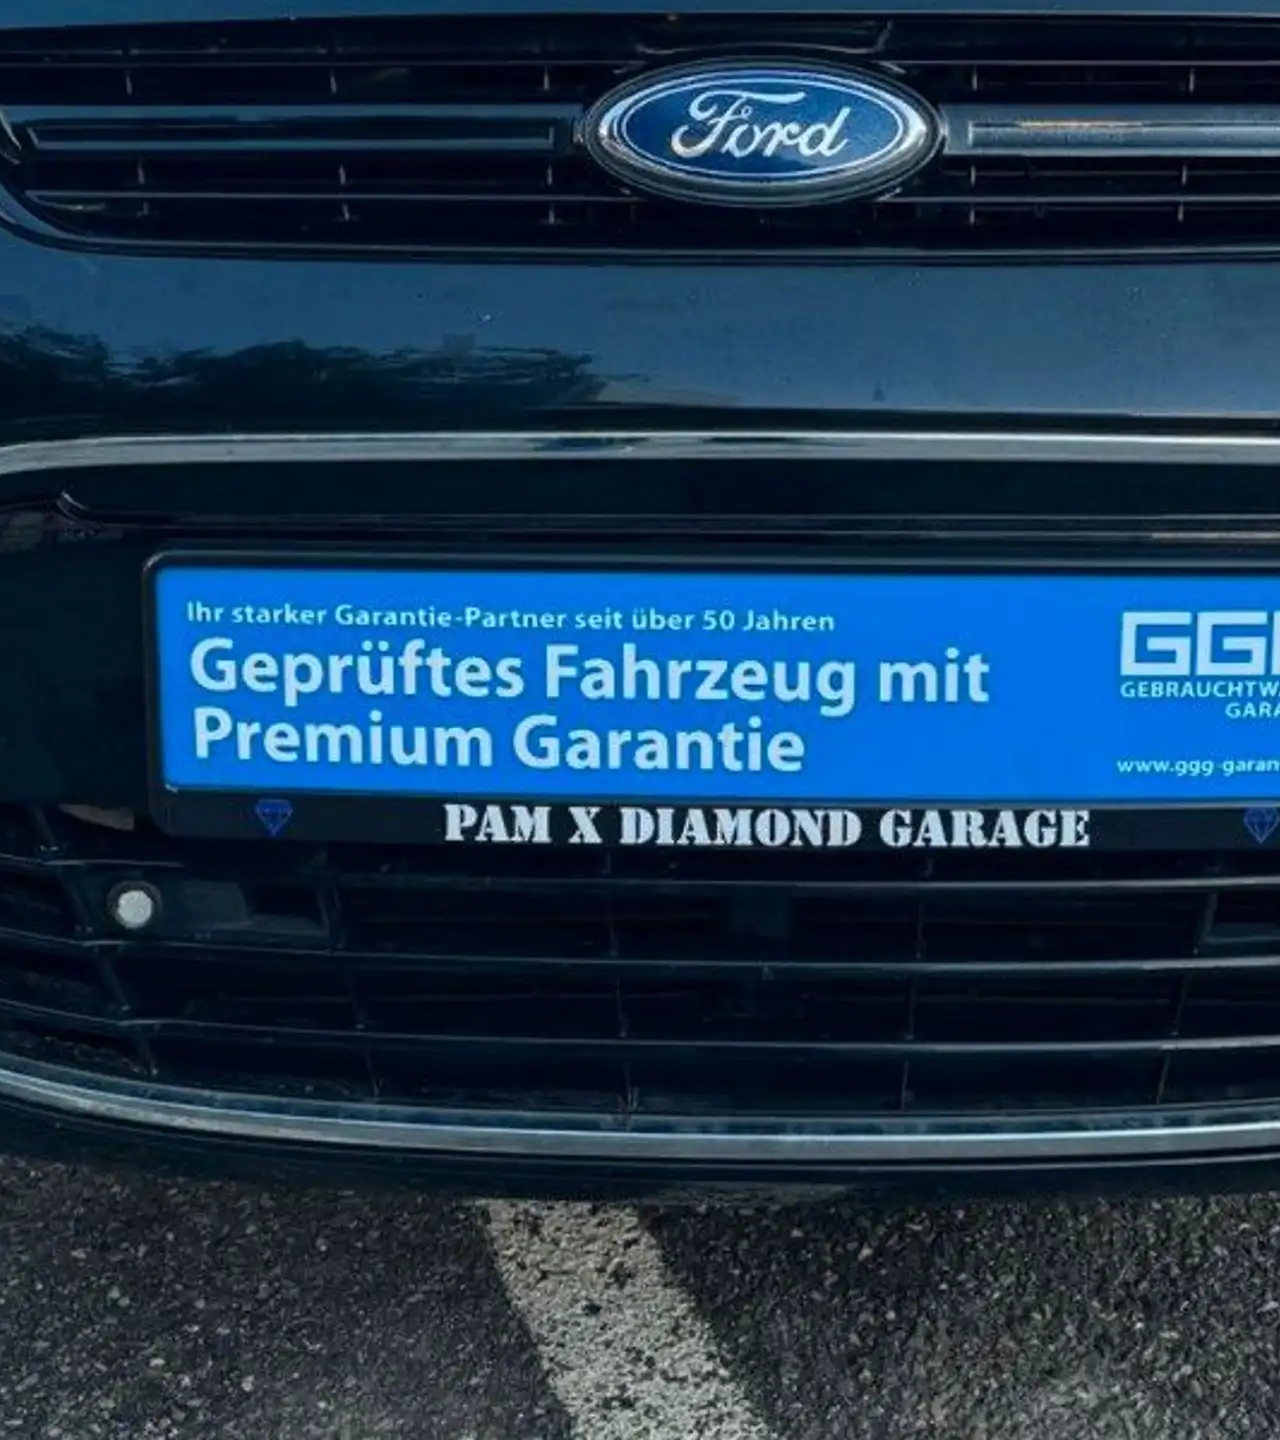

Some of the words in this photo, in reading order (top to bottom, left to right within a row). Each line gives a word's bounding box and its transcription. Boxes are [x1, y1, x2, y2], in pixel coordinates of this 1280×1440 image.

[670, 90, 850, 158] Ford
[187, 602, 221, 623] Ihr
[232, 606, 326, 625] starker
[334, 606, 565, 630] Garantie-Partner
[575, 612, 623, 630] seit
[631, 610, 692, 631] über
[701, 611, 735, 631] 50
[742, 611, 835, 633] Jahren
[191, 637, 524, 707] Geprüftes
[546, 643, 855, 717] Fahrzeug
[880, 647, 990, 702] mit
[195, 707, 492, 766] Premium
[513, 715, 805, 772] Garantie
[444, 803, 551, 844] PAM
[568, 806, 604, 845] X
[620, 807, 862, 847] DIAMOND
[879, 809, 1091, 849] GARAGE
